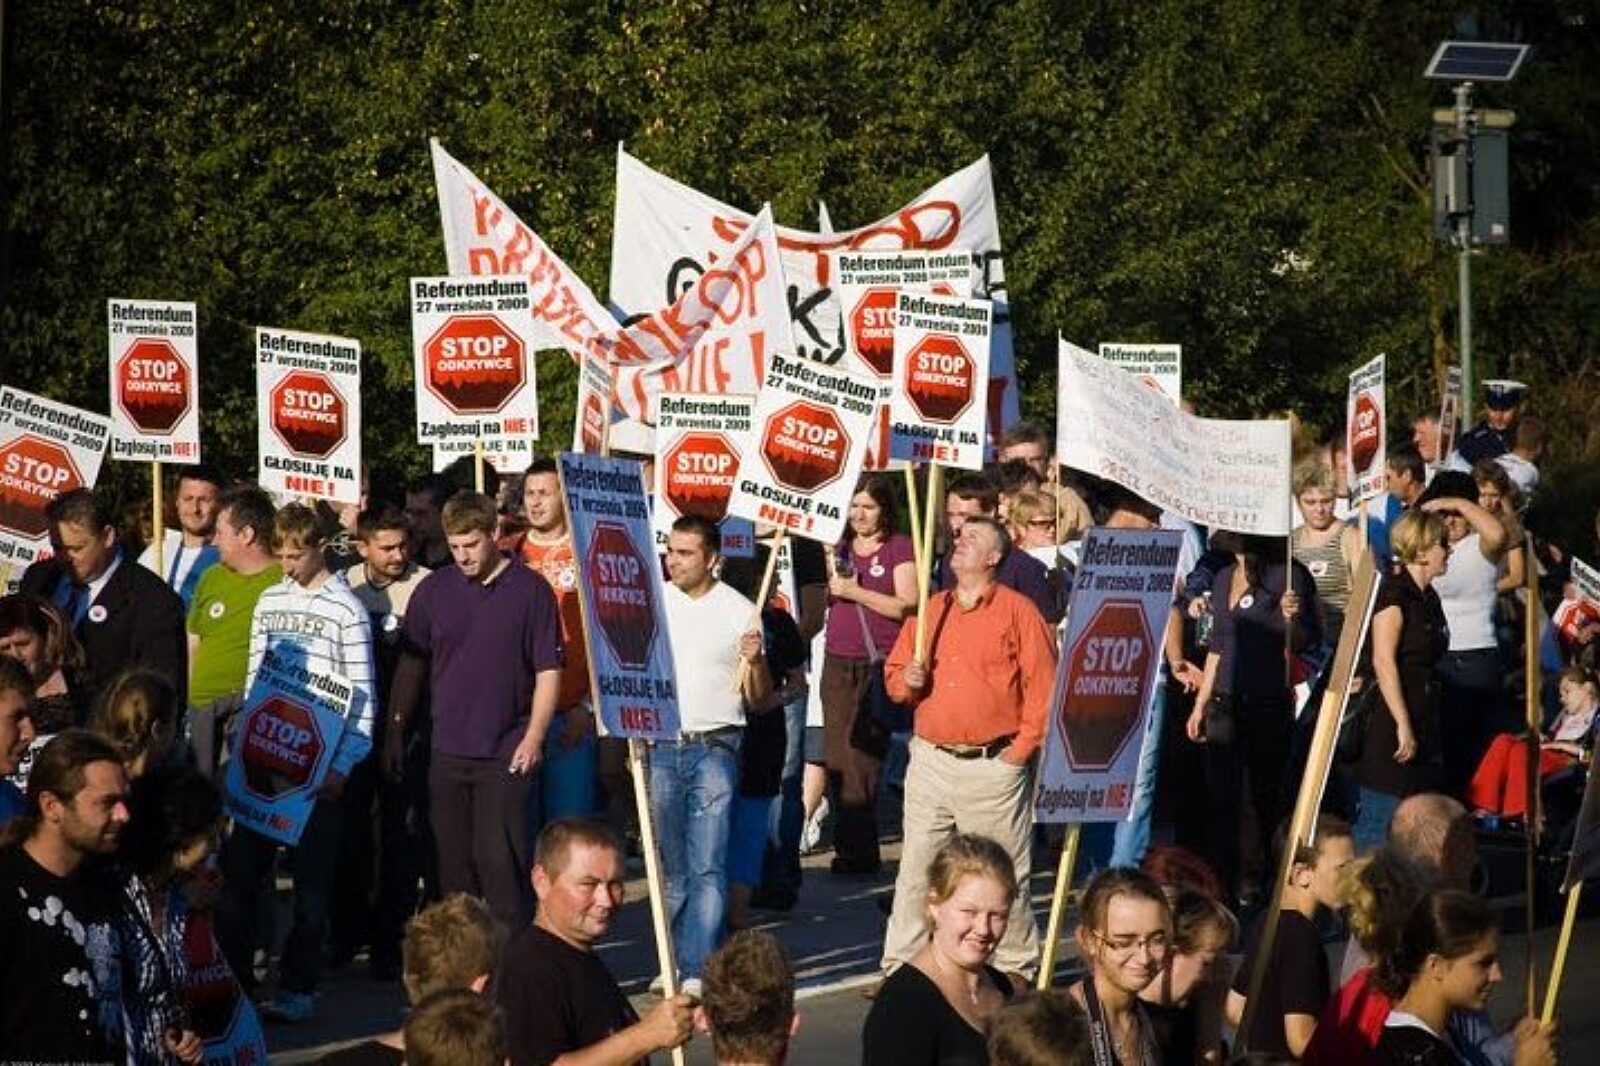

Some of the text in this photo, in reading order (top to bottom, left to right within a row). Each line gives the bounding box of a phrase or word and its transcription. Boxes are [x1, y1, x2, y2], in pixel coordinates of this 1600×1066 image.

[839, 256, 925, 271] Referendum
[416, 280, 528, 298] Referendum
[112, 304, 192, 322] Referendum
[416, 301, 431, 313] 27
[497, 298, 529, 310] 2009
[900, 294, 988, 322] Referendum
[260, 333, 357, 361] Referendum
[260, 351, 273, 363] 27
[441, 336, 508, 358] STOP
[1102, 346, 1177, 363] Referendum
[129, 359, 178, 380] STOP
[917, 352, 966, 372] STOP
[770, 355, 877, 400] Referendum
[283, 388, 335, 412] STOP
[660, 397, 750, 416] Referendum
[766, 376, 782, 389] 27
[841, 397, 874, 416] 2009
[1, 391, 107, 437] Referendum
[660, 416, 672, 427] 27
[420, 420, 481, 438] Zagłosuj
[483, 421, 501, 434] na
[783, 416, 838, 446] STOP
[960, 430, 979, 445] NA
[72, 433, 103, 452] 2009
[5, 452, 70, 486] STOP
[265, 455, 355, 481] GŁOSUJĘ NA
[678, 452, 731, 472] STOP
[741, 480, 841, 520] GŁOSUJĘ NA
[758, 505, 802, 529] NIE
[1084, 535, 1179, 567] Referendum
[598, 554, 640, 586] STOP
[1077, 574, 1093, 589] 27
[1083, 637, 1143, 671] STOP
[1074, 676, 1140, 696] ODKRYWCE
[255, 712, 311, 748] STOP
